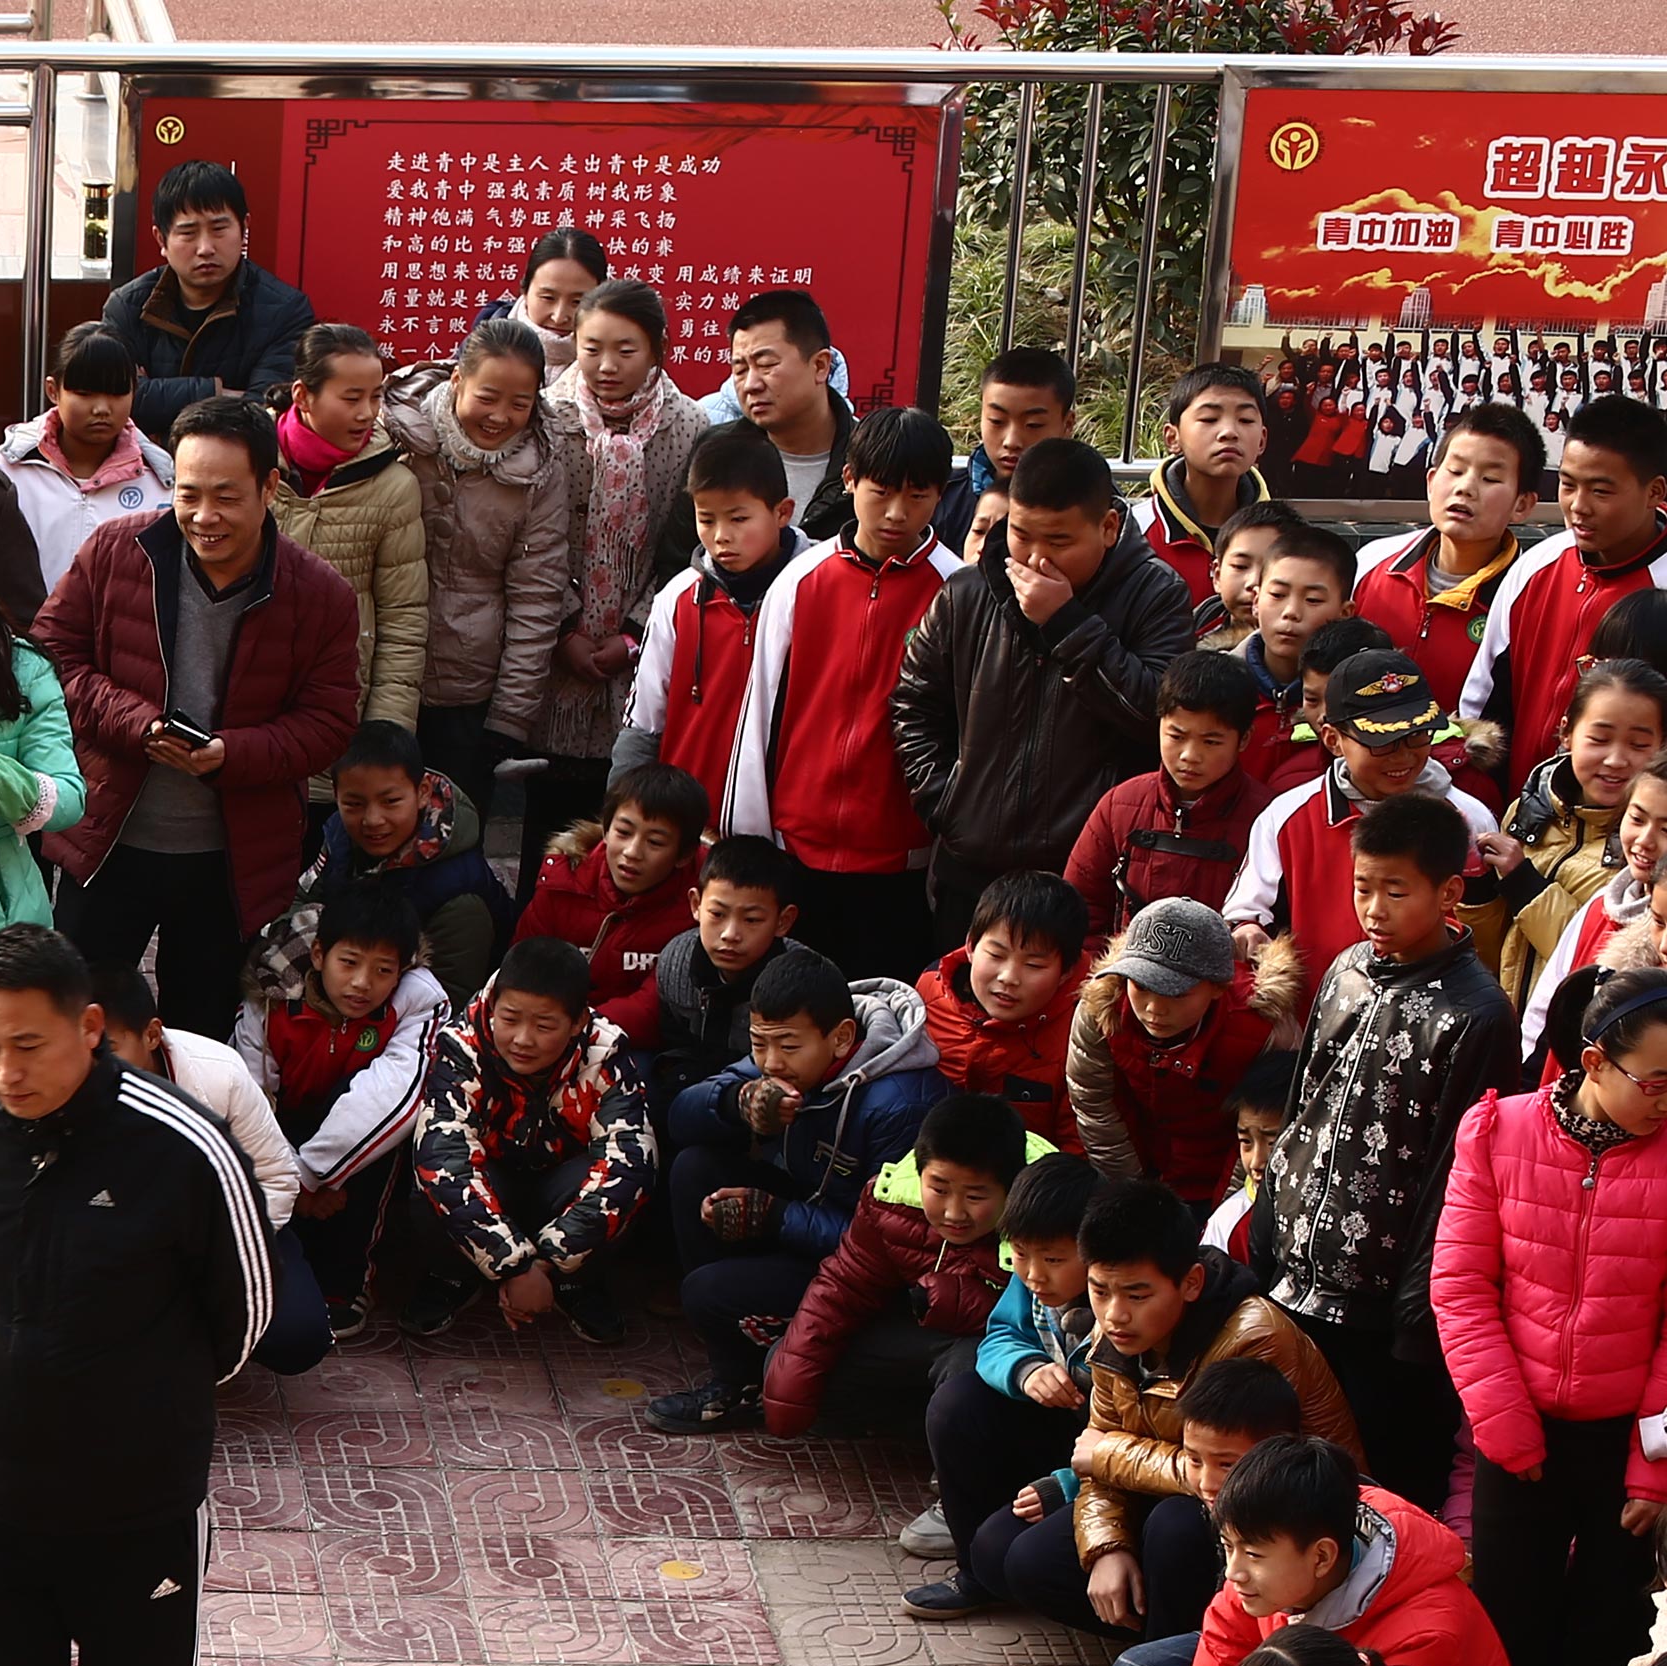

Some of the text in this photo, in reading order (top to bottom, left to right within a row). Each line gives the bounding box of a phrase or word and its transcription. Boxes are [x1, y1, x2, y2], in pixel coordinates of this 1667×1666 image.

[386, 151, 721, 176] 走进青中是主人 走出青中是成功
[386, 178, 677, 203] 爱我青中 强我素质 树我形象
[383, 206, 676, 230] 精神饱满 气势旺盛 神采飞扬
[1318, 211, 1634, 256] 青中加油 青中必胜
[382, 233, 473, 254] 和高的比
[598, 236, 676, 259] 快的赛
[380, 261, 519, 281] 用思想来说话
[675, 264, 812, 285] 用成绩来证明
[674, 291, 760, 312] 实力就
[378, 314, 468, 334] 永不言败
